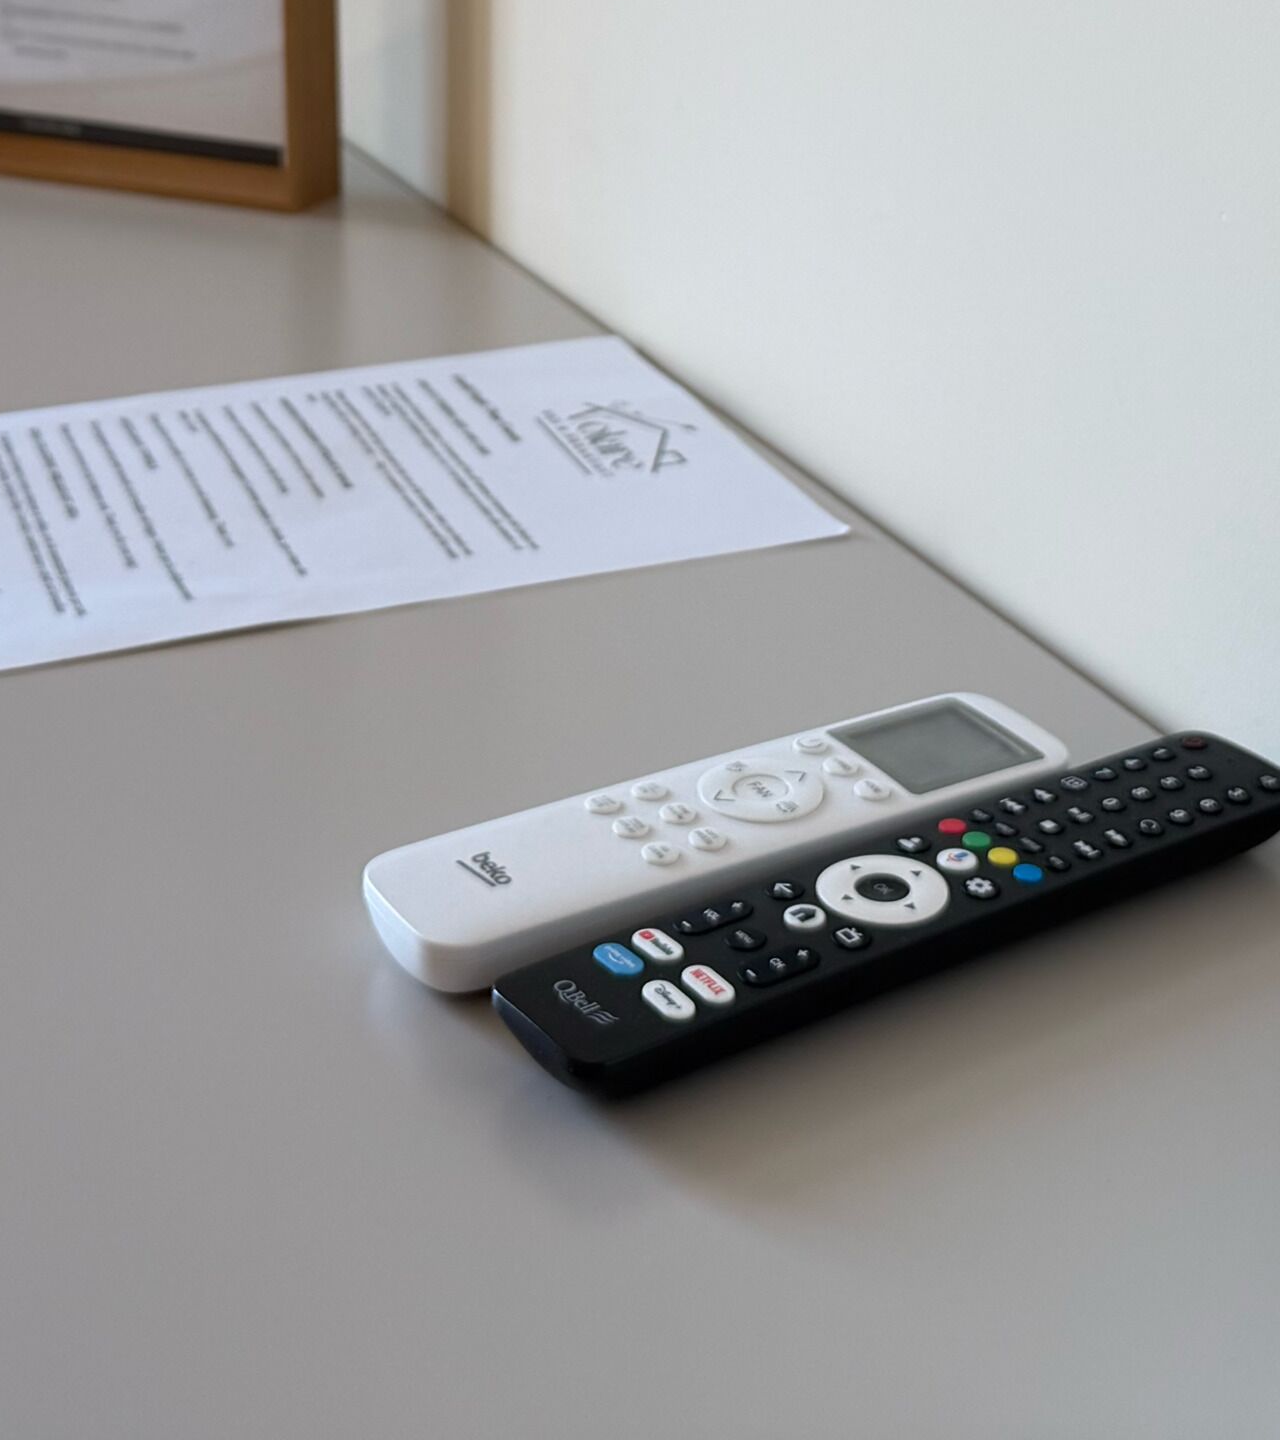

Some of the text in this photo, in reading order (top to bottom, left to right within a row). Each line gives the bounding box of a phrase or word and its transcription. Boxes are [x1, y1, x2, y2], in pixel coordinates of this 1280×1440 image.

[471, 851, 512, 885] beko
[770, 958, 786, 969] CH
[690, 968, 727, 996] NETFLIX
